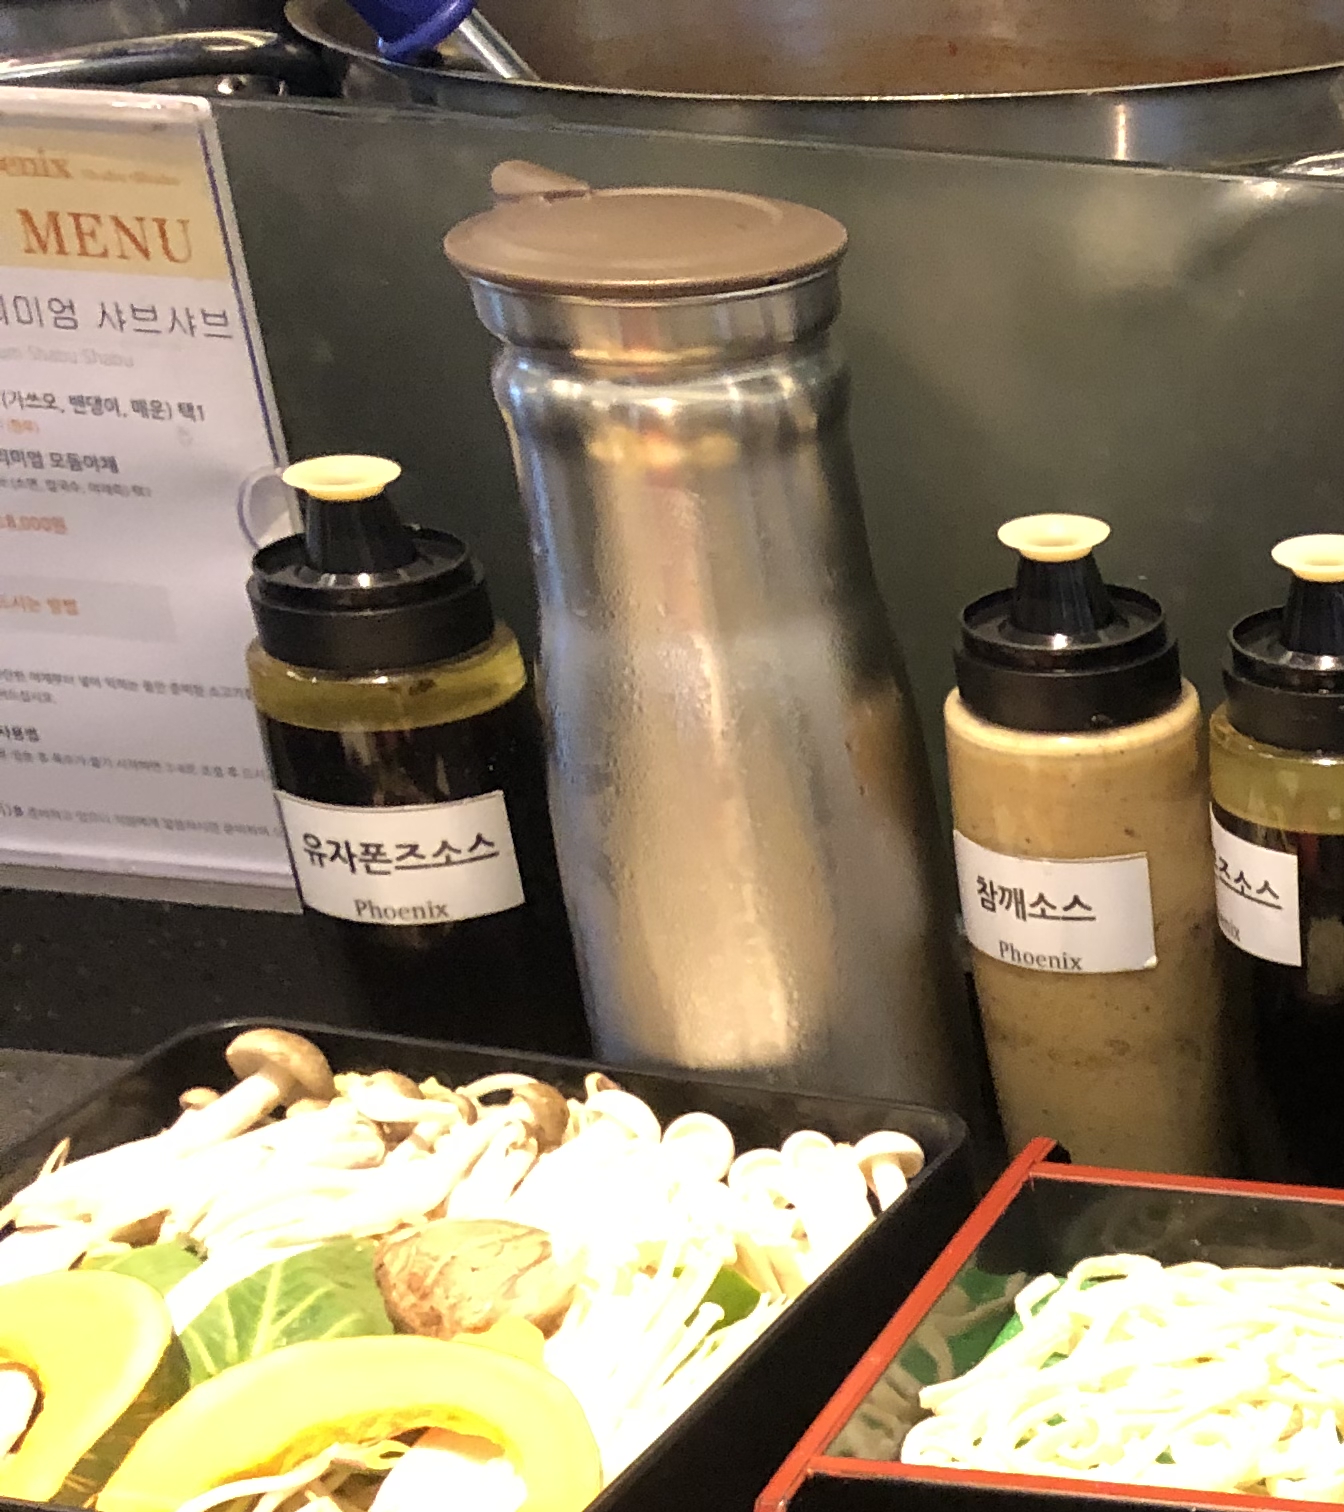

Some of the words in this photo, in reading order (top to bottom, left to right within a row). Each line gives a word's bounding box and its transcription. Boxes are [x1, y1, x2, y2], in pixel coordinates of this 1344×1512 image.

[0, 148, 73, 180] enix
[16, 209, 192, 263] MENU
[99, 301, 233, 339] 샤브샤브
[303, 832, 499, 875] 유자폰즈소스
[354, 898, 450, 922] Phoenix
[977, 875, 1096, 921] 참깨소스
[999, 940, 1083, 971] Phoenix
